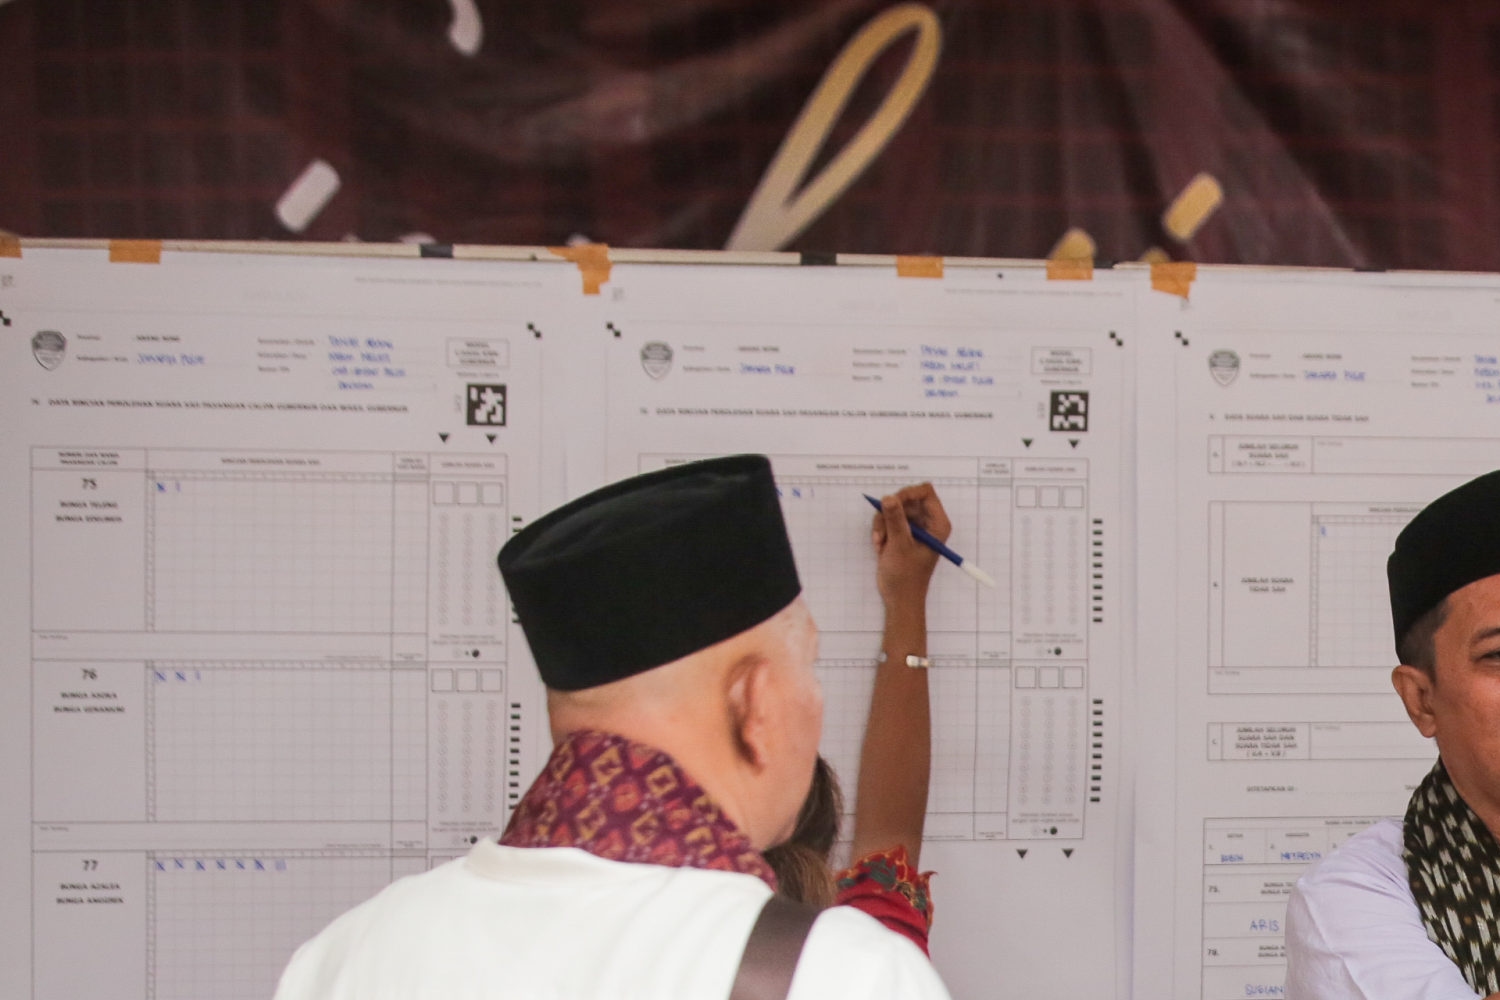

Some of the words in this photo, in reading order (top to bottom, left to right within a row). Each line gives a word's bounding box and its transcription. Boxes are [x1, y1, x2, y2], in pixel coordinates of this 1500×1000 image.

[81, 477, 97, 490] 75
[81, 667, 98, 680] 76
[82, 859, 98, 871] 77
[1249, 920, 1280, 932] ARIS
